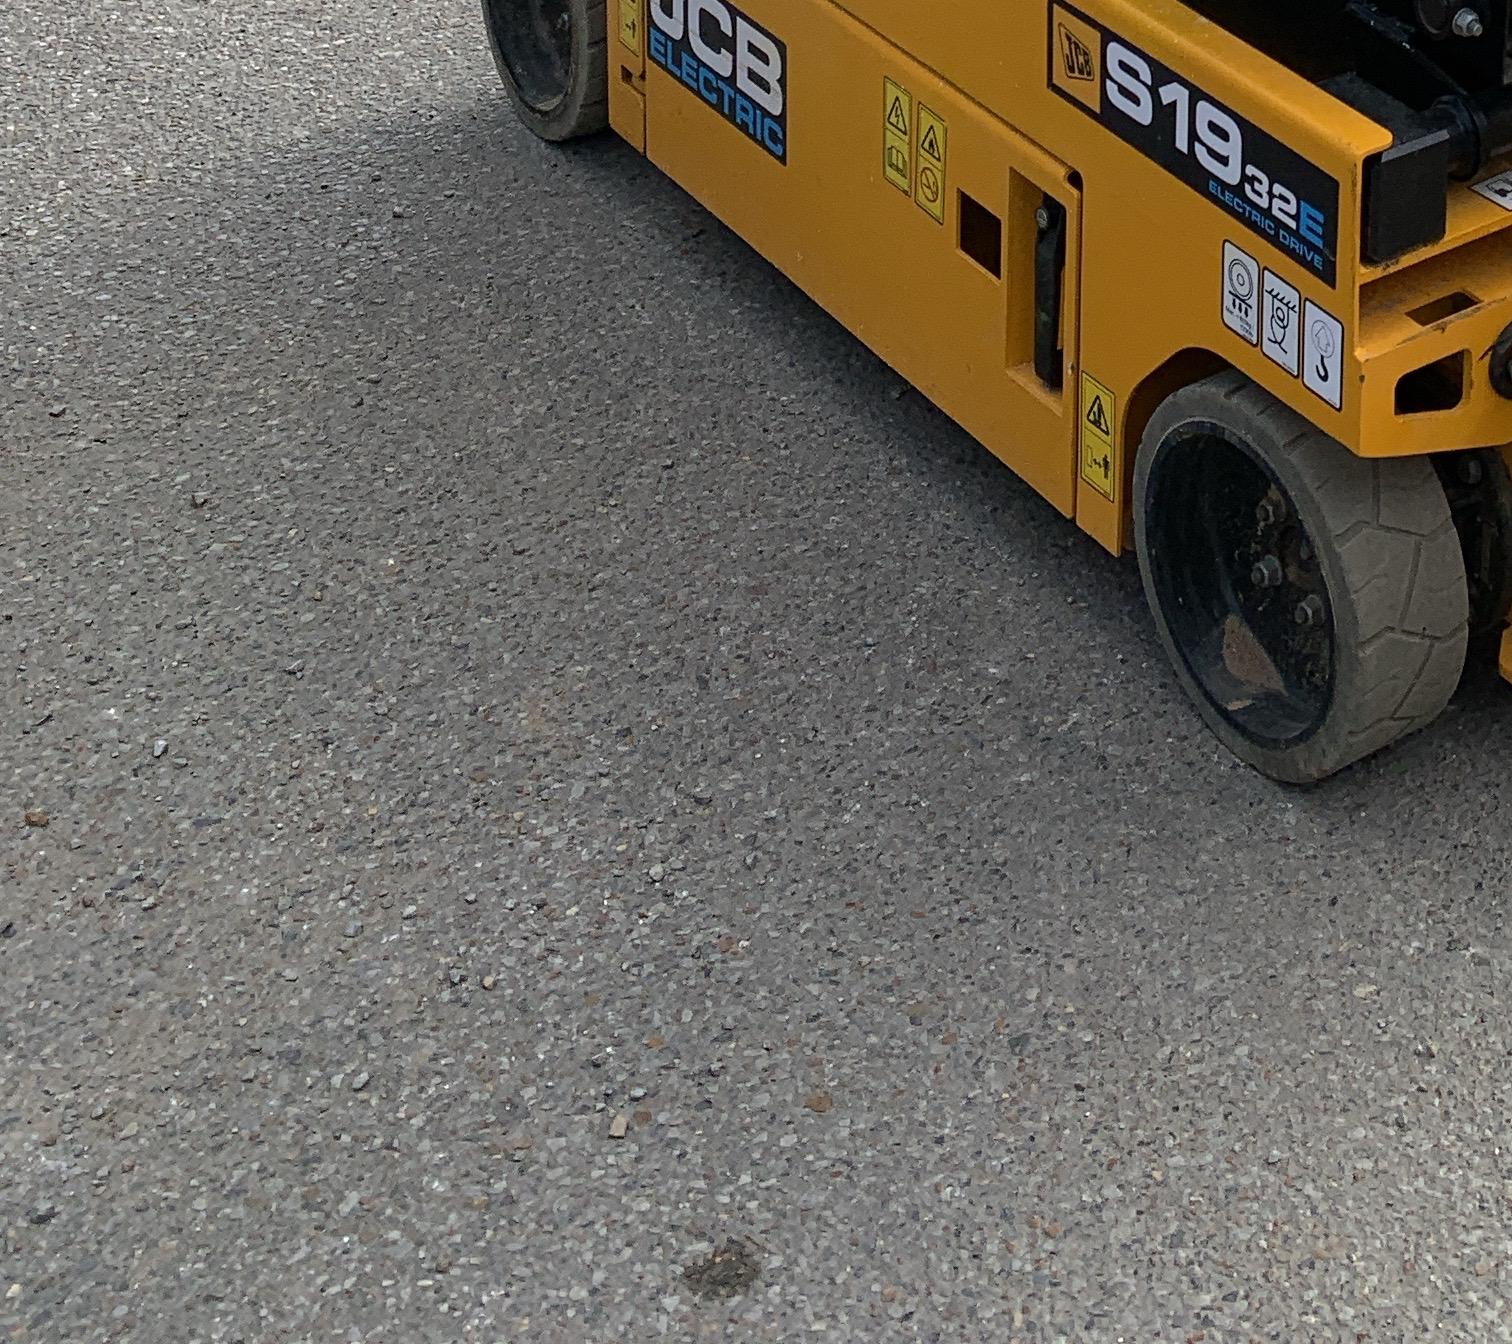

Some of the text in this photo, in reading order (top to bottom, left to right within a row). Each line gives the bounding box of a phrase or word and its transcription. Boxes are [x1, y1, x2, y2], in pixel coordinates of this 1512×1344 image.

[650, 26, 785, 157] ELECTRIC
[1065, 34, 1092, 78] JCB
[1208, 178, 1323, 272] ELECTRIC DRIVE
